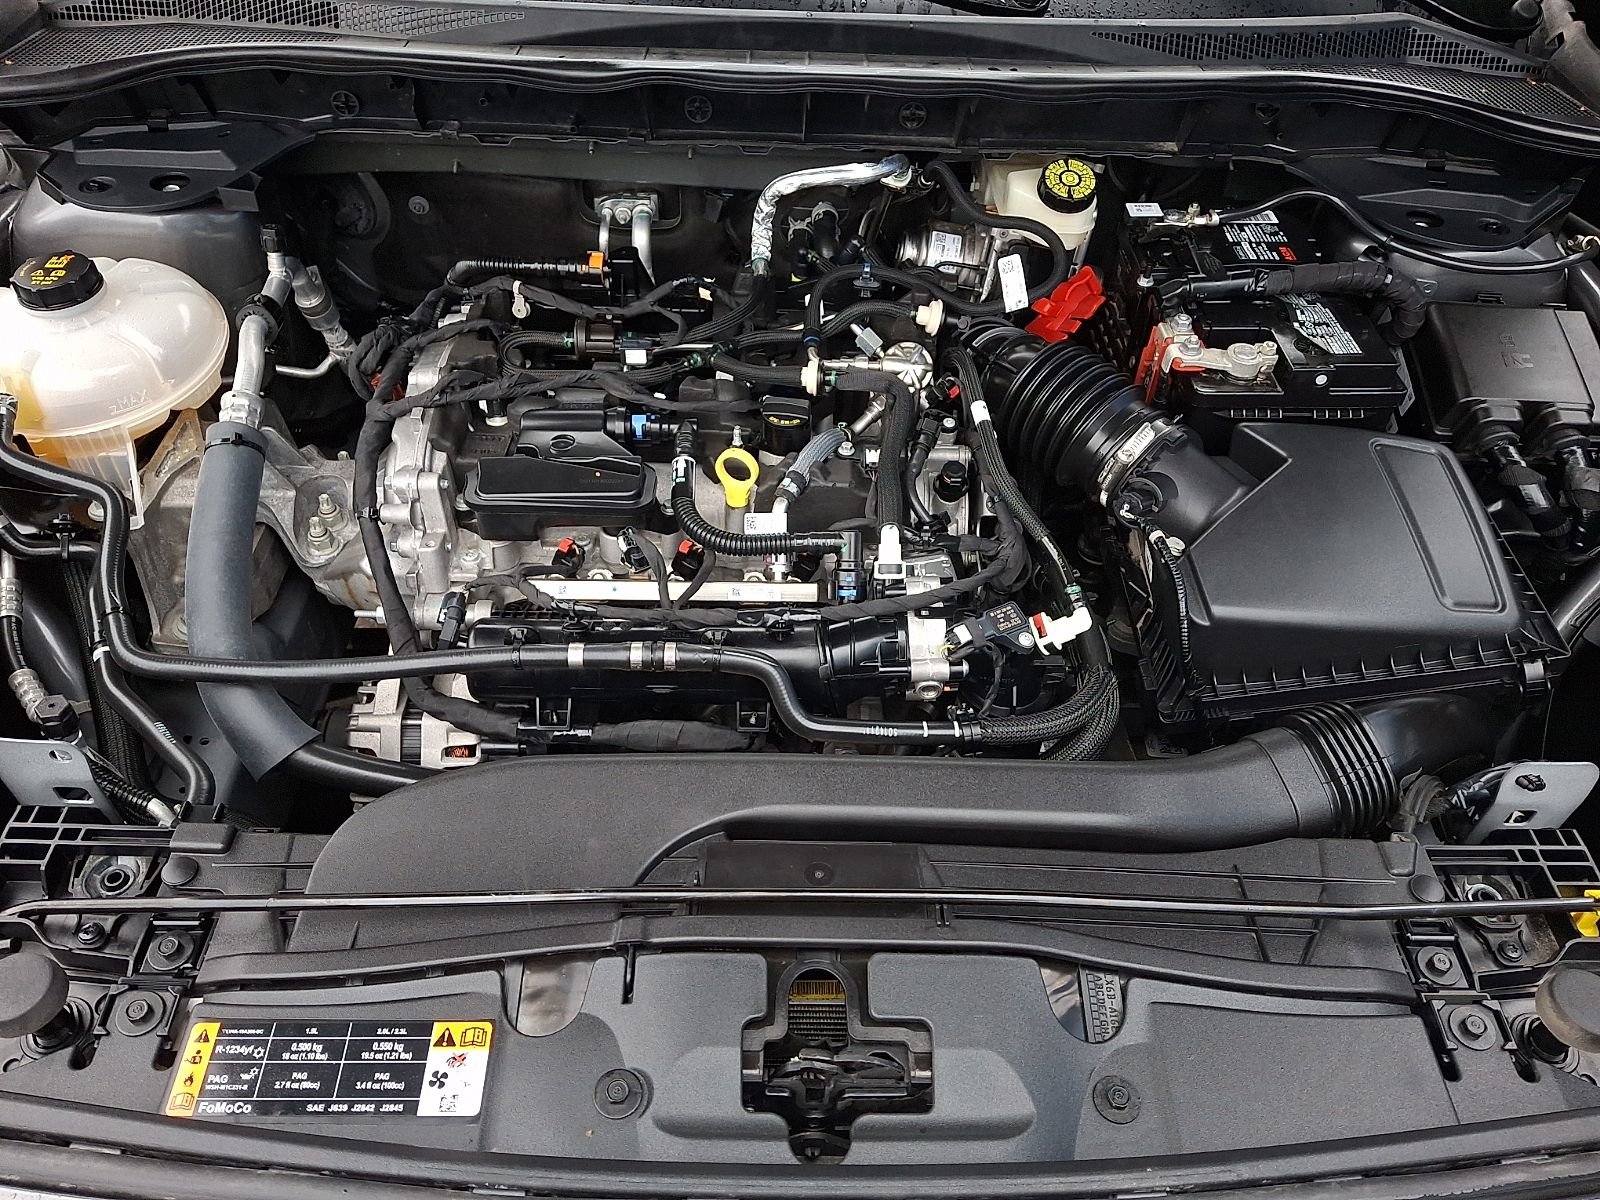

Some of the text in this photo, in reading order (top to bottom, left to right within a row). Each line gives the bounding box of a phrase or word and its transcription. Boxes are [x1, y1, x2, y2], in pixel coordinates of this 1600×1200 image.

[215, 1045, 254, 1055] R-1234yf
[312, 1043, 324, 1053] kg
[394, 1042, 405, 1053] kg
[208, 1075, 229, 1083] PAG
[291, 1072, 308, 1080] PAG
[374, 1072, 391, 1080] PAG
[198, 1101, 252, 1114] FoMoCo
[306, 1103, 325, 1112] SAE
